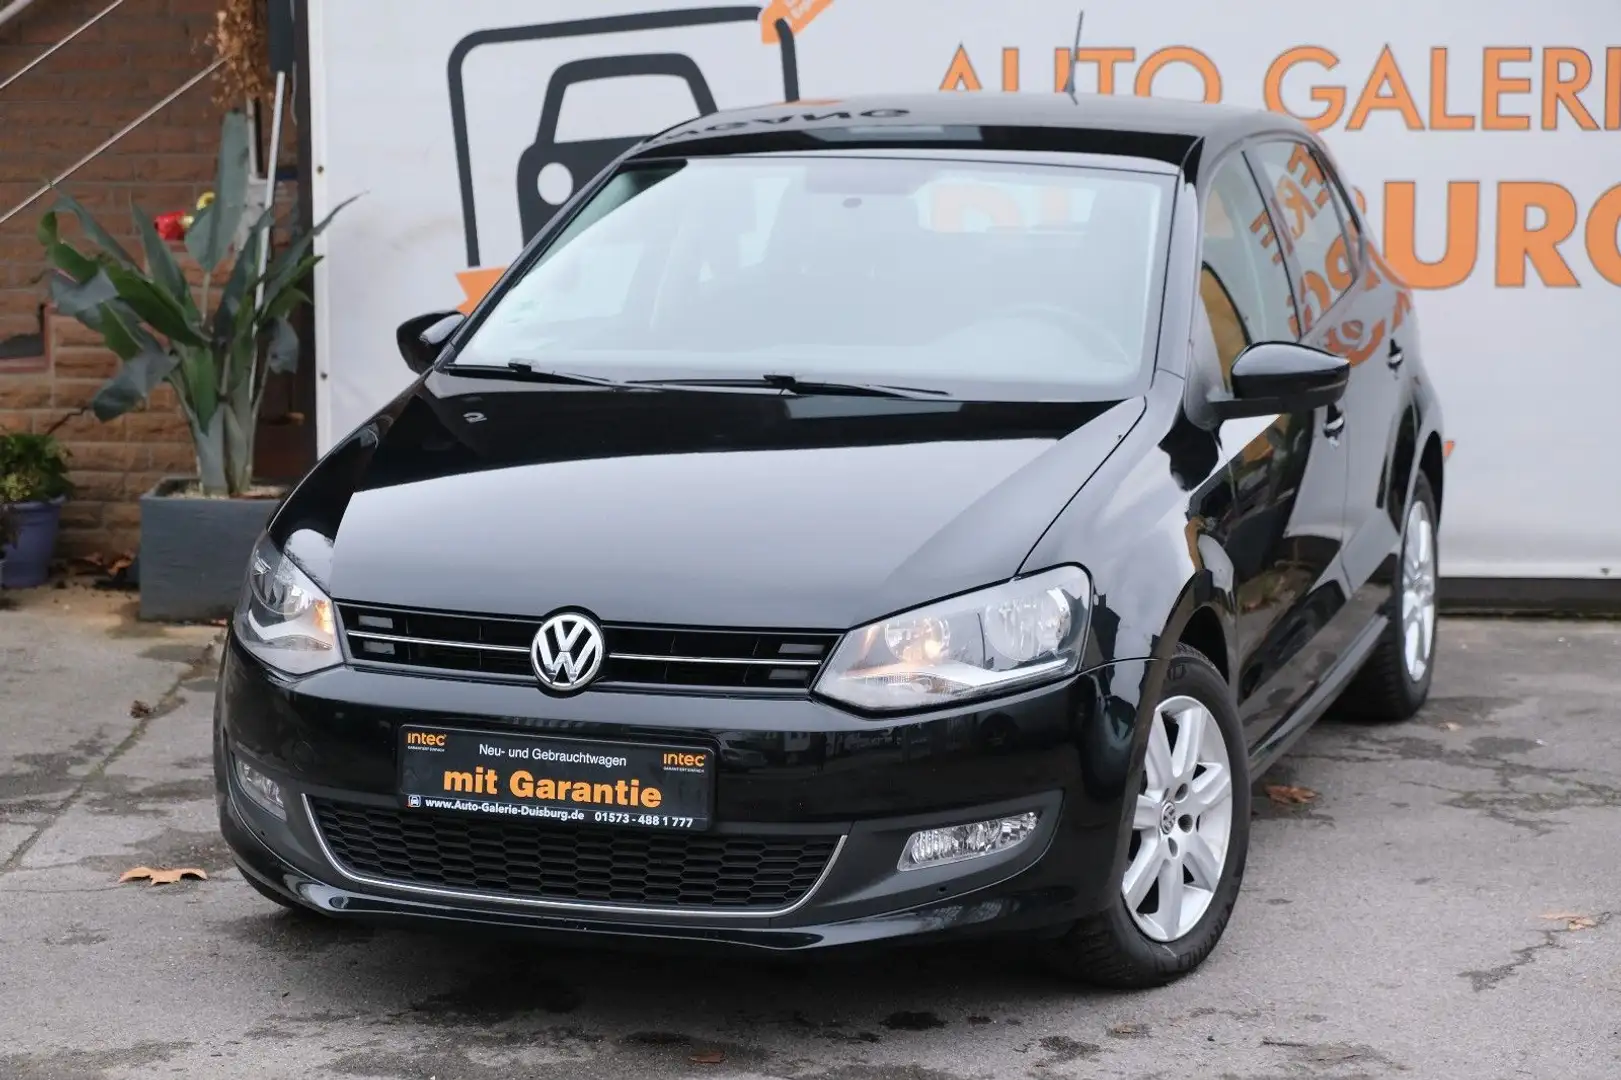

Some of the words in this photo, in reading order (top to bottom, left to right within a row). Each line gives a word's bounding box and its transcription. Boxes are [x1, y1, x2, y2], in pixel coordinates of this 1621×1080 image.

[939, 42, 1222, 104] AUTO
[407, 731, 446, 746] intec
[479, 743, 506, 757] Neu-
[508, 747, 529, 759] und
[532, 747, 627, 769] Gebrauchtwagen
[663, 752, 706, 767] intec
[443, 766, 498, 795] mit
[509, 769, 662, 808] Garantie
[425, 798, 585, 821] www.Auto-Galerie-Duisburg.de
[594, 811, 630, 824] 01573
[637, 814, 660, 826] 488
[672, 817, 694, 828] 777
